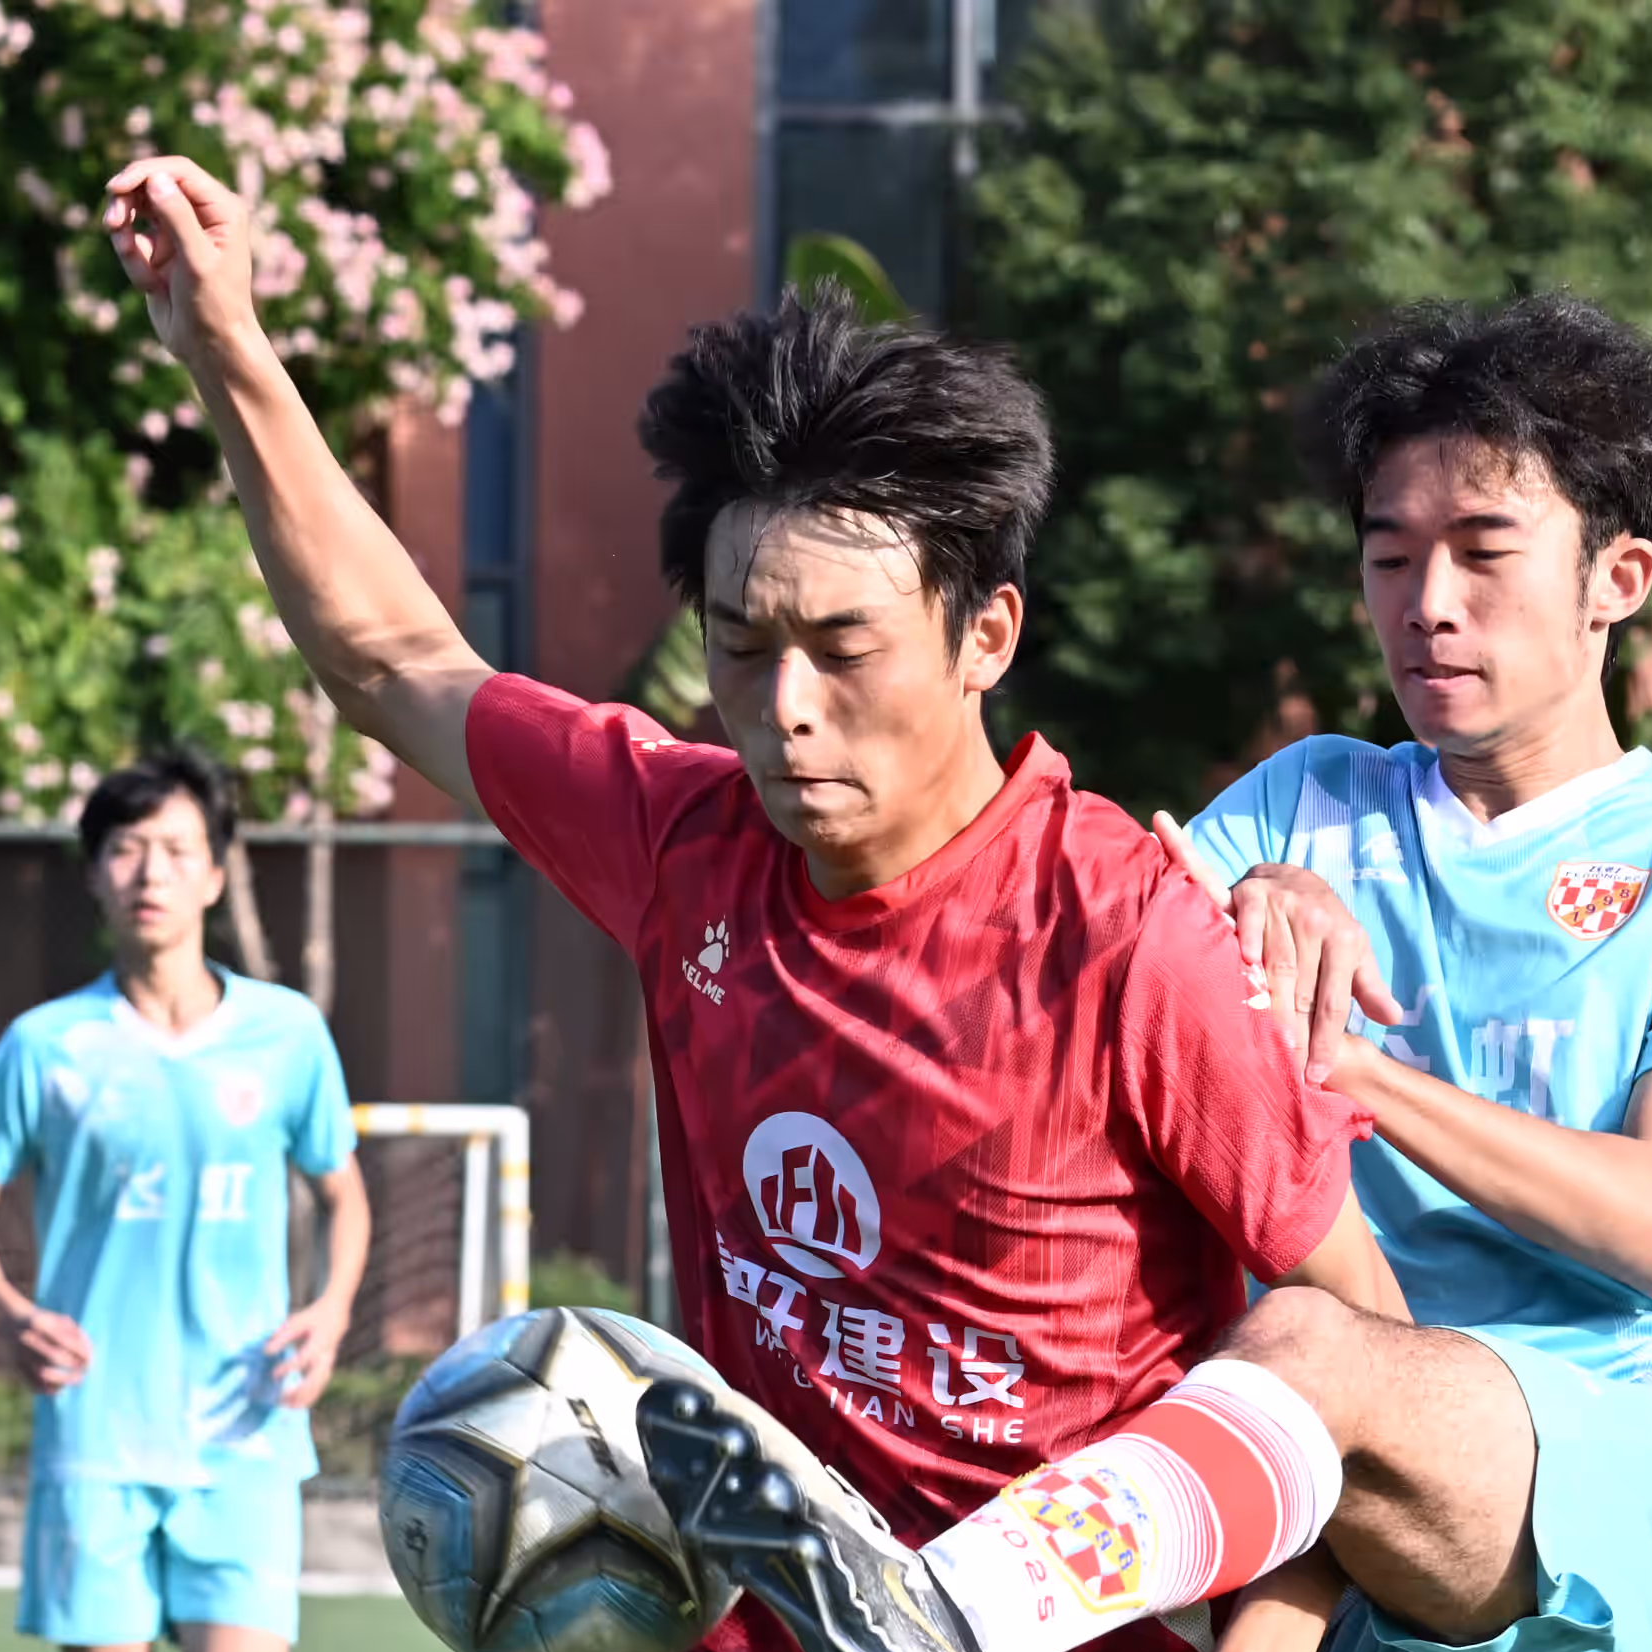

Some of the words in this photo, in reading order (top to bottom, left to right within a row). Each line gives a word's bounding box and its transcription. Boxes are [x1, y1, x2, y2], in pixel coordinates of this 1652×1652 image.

[1573, 888, 1630, 922] 1998
[682, 955, 726, 1006] KELME
[940, 1414, 1025, 1444] SHE
